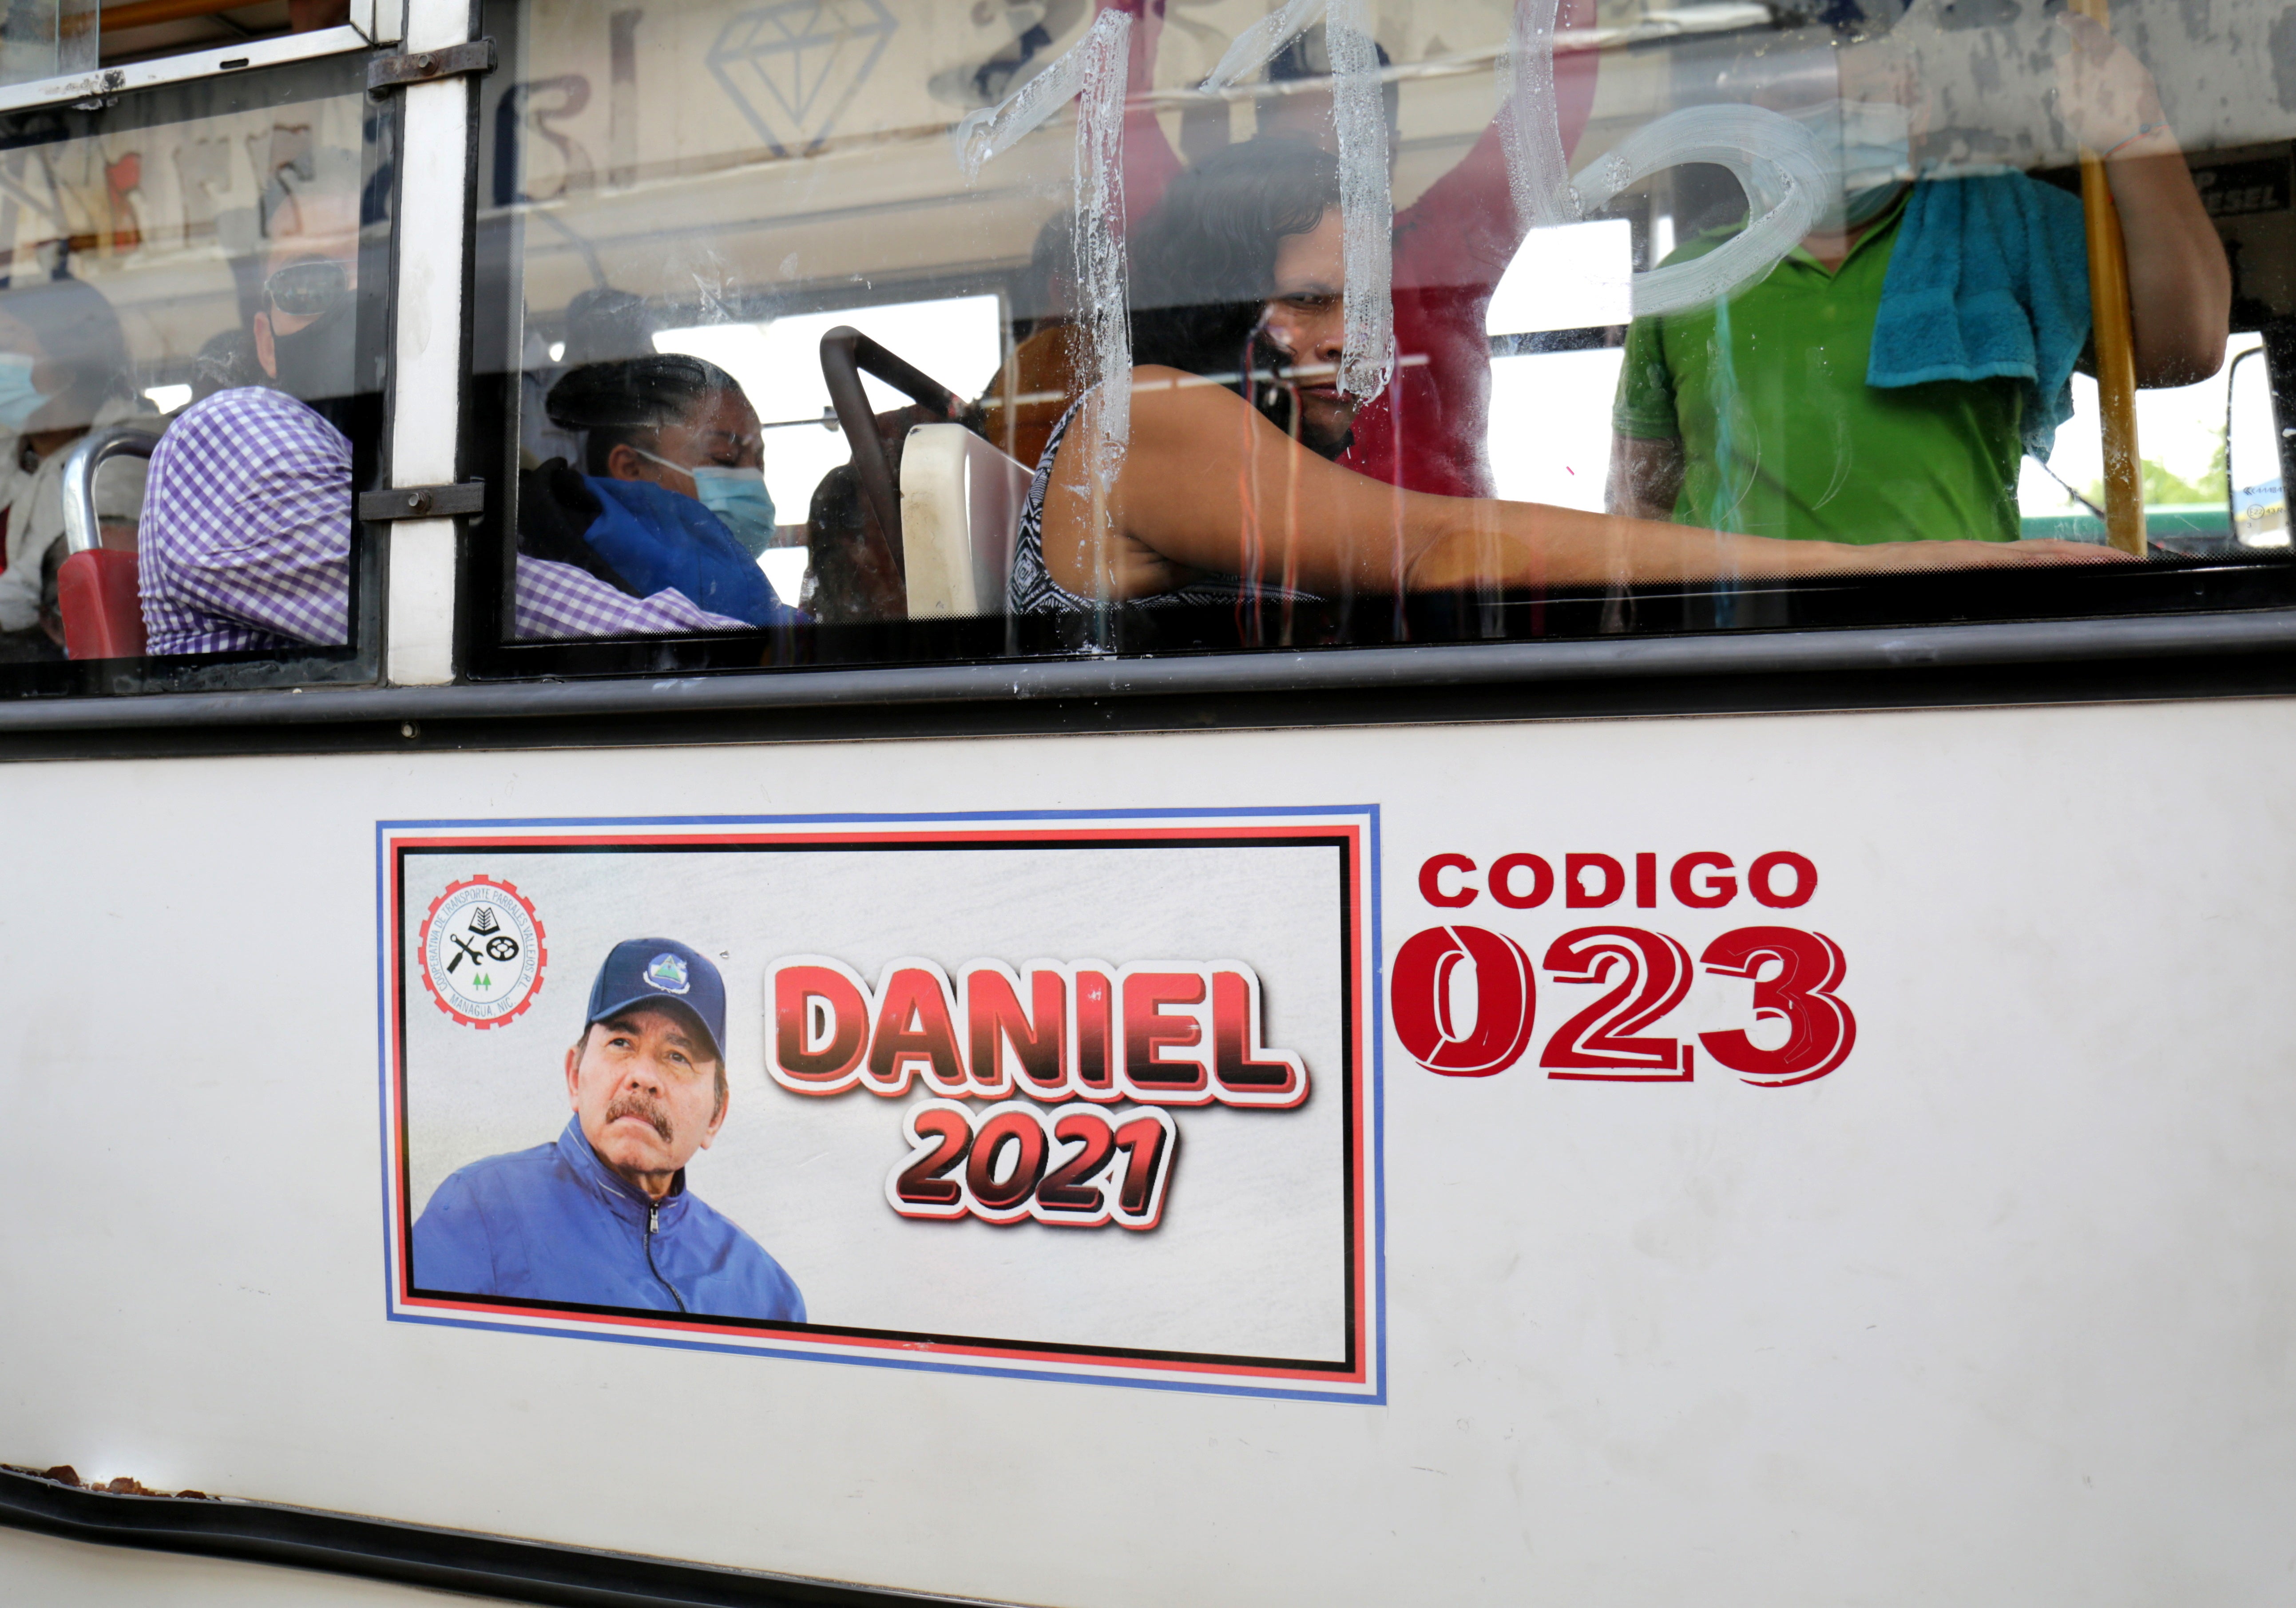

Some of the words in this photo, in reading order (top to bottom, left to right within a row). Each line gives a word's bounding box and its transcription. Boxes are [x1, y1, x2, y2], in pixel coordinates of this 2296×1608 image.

[441, 888, 491, 917] TRANSPORTE
[1418, 851, 1818, 909] CODIGO
[435, 915, 446, 928] DE
[492, 890, 528, 927] PARRALES
[429, 930, 448, 991] COOPERATIVA
[523, 926, 536, 973] VALLEJOS
[497, 997, 516, 1013] NIC.
[770, 960, 1303, 1100] DANIEL
[1391, 925, 1857, 1088] 023
[892, 1103, 1172, 1222] 2021
